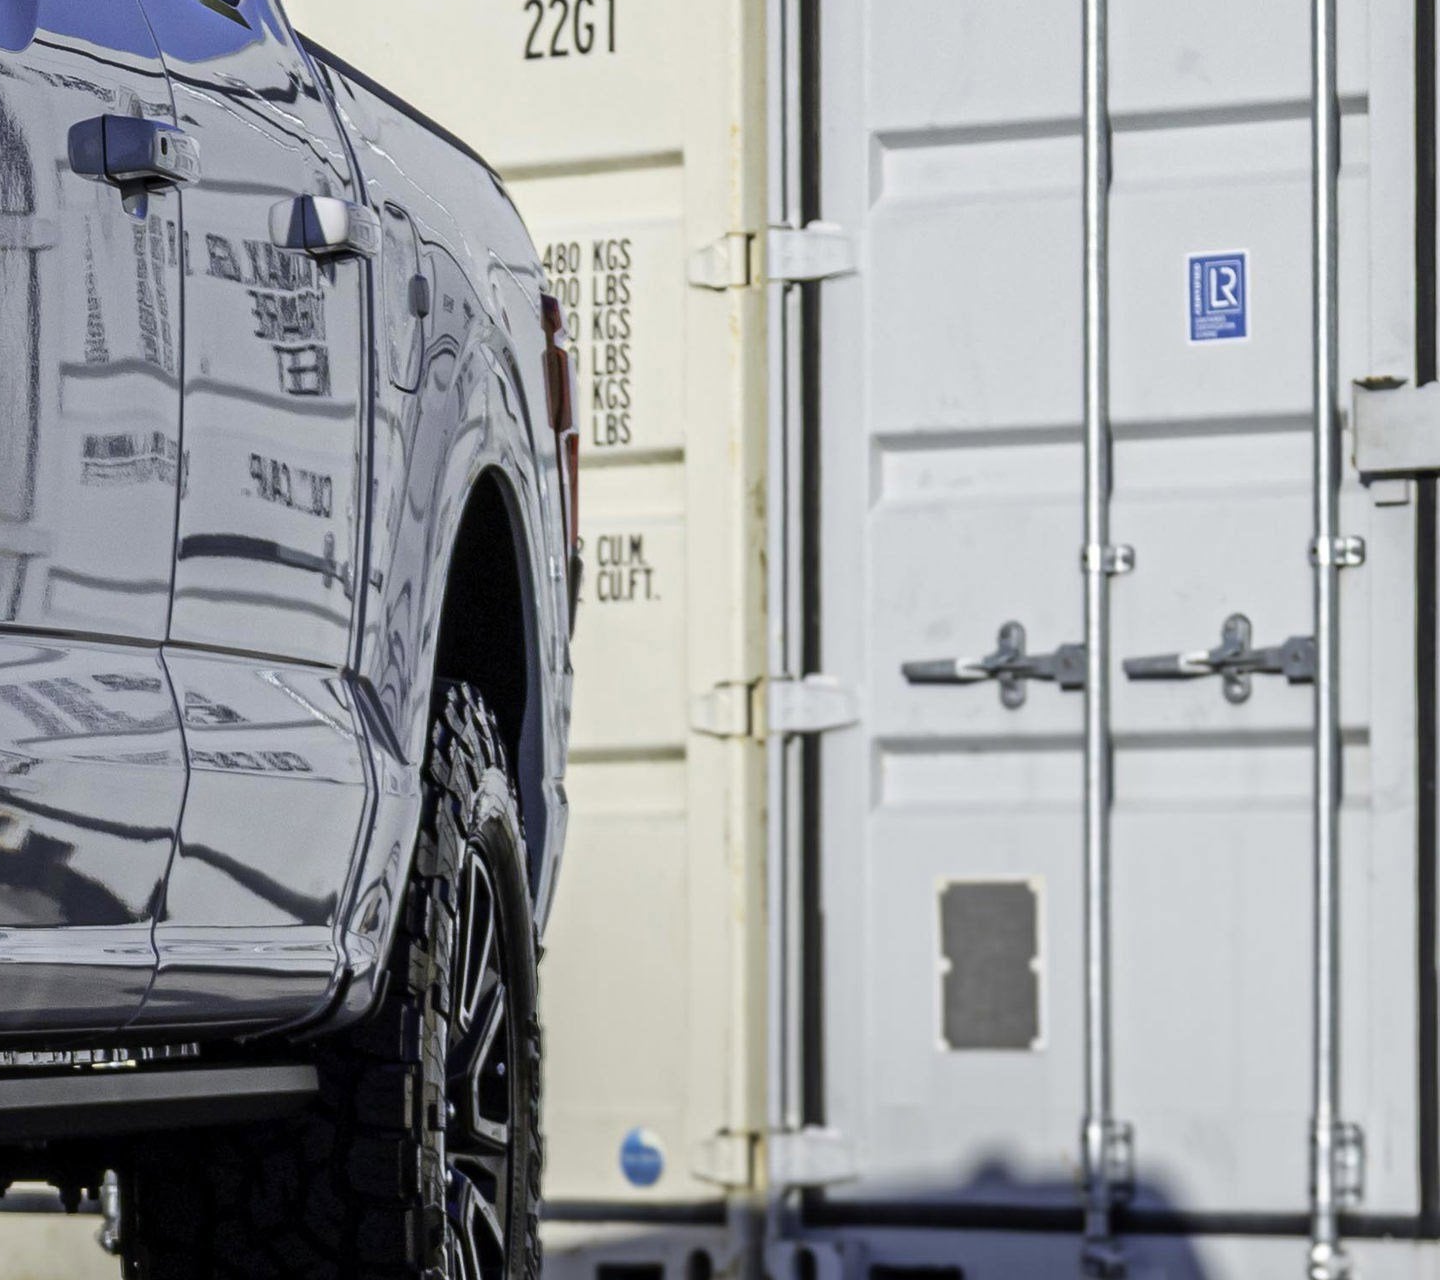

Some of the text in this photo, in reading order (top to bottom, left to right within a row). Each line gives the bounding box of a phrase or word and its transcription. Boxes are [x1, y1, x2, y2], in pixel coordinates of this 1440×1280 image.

[592, 238, 631, 272] KGS
[592, 273, 631, 307] LBS
[592, 308, 631, 341] KGS
[592, 343, 631, 376] LBS
[592, 377, 631, 411] KGS
[592, 412, 632, 447] LBS
